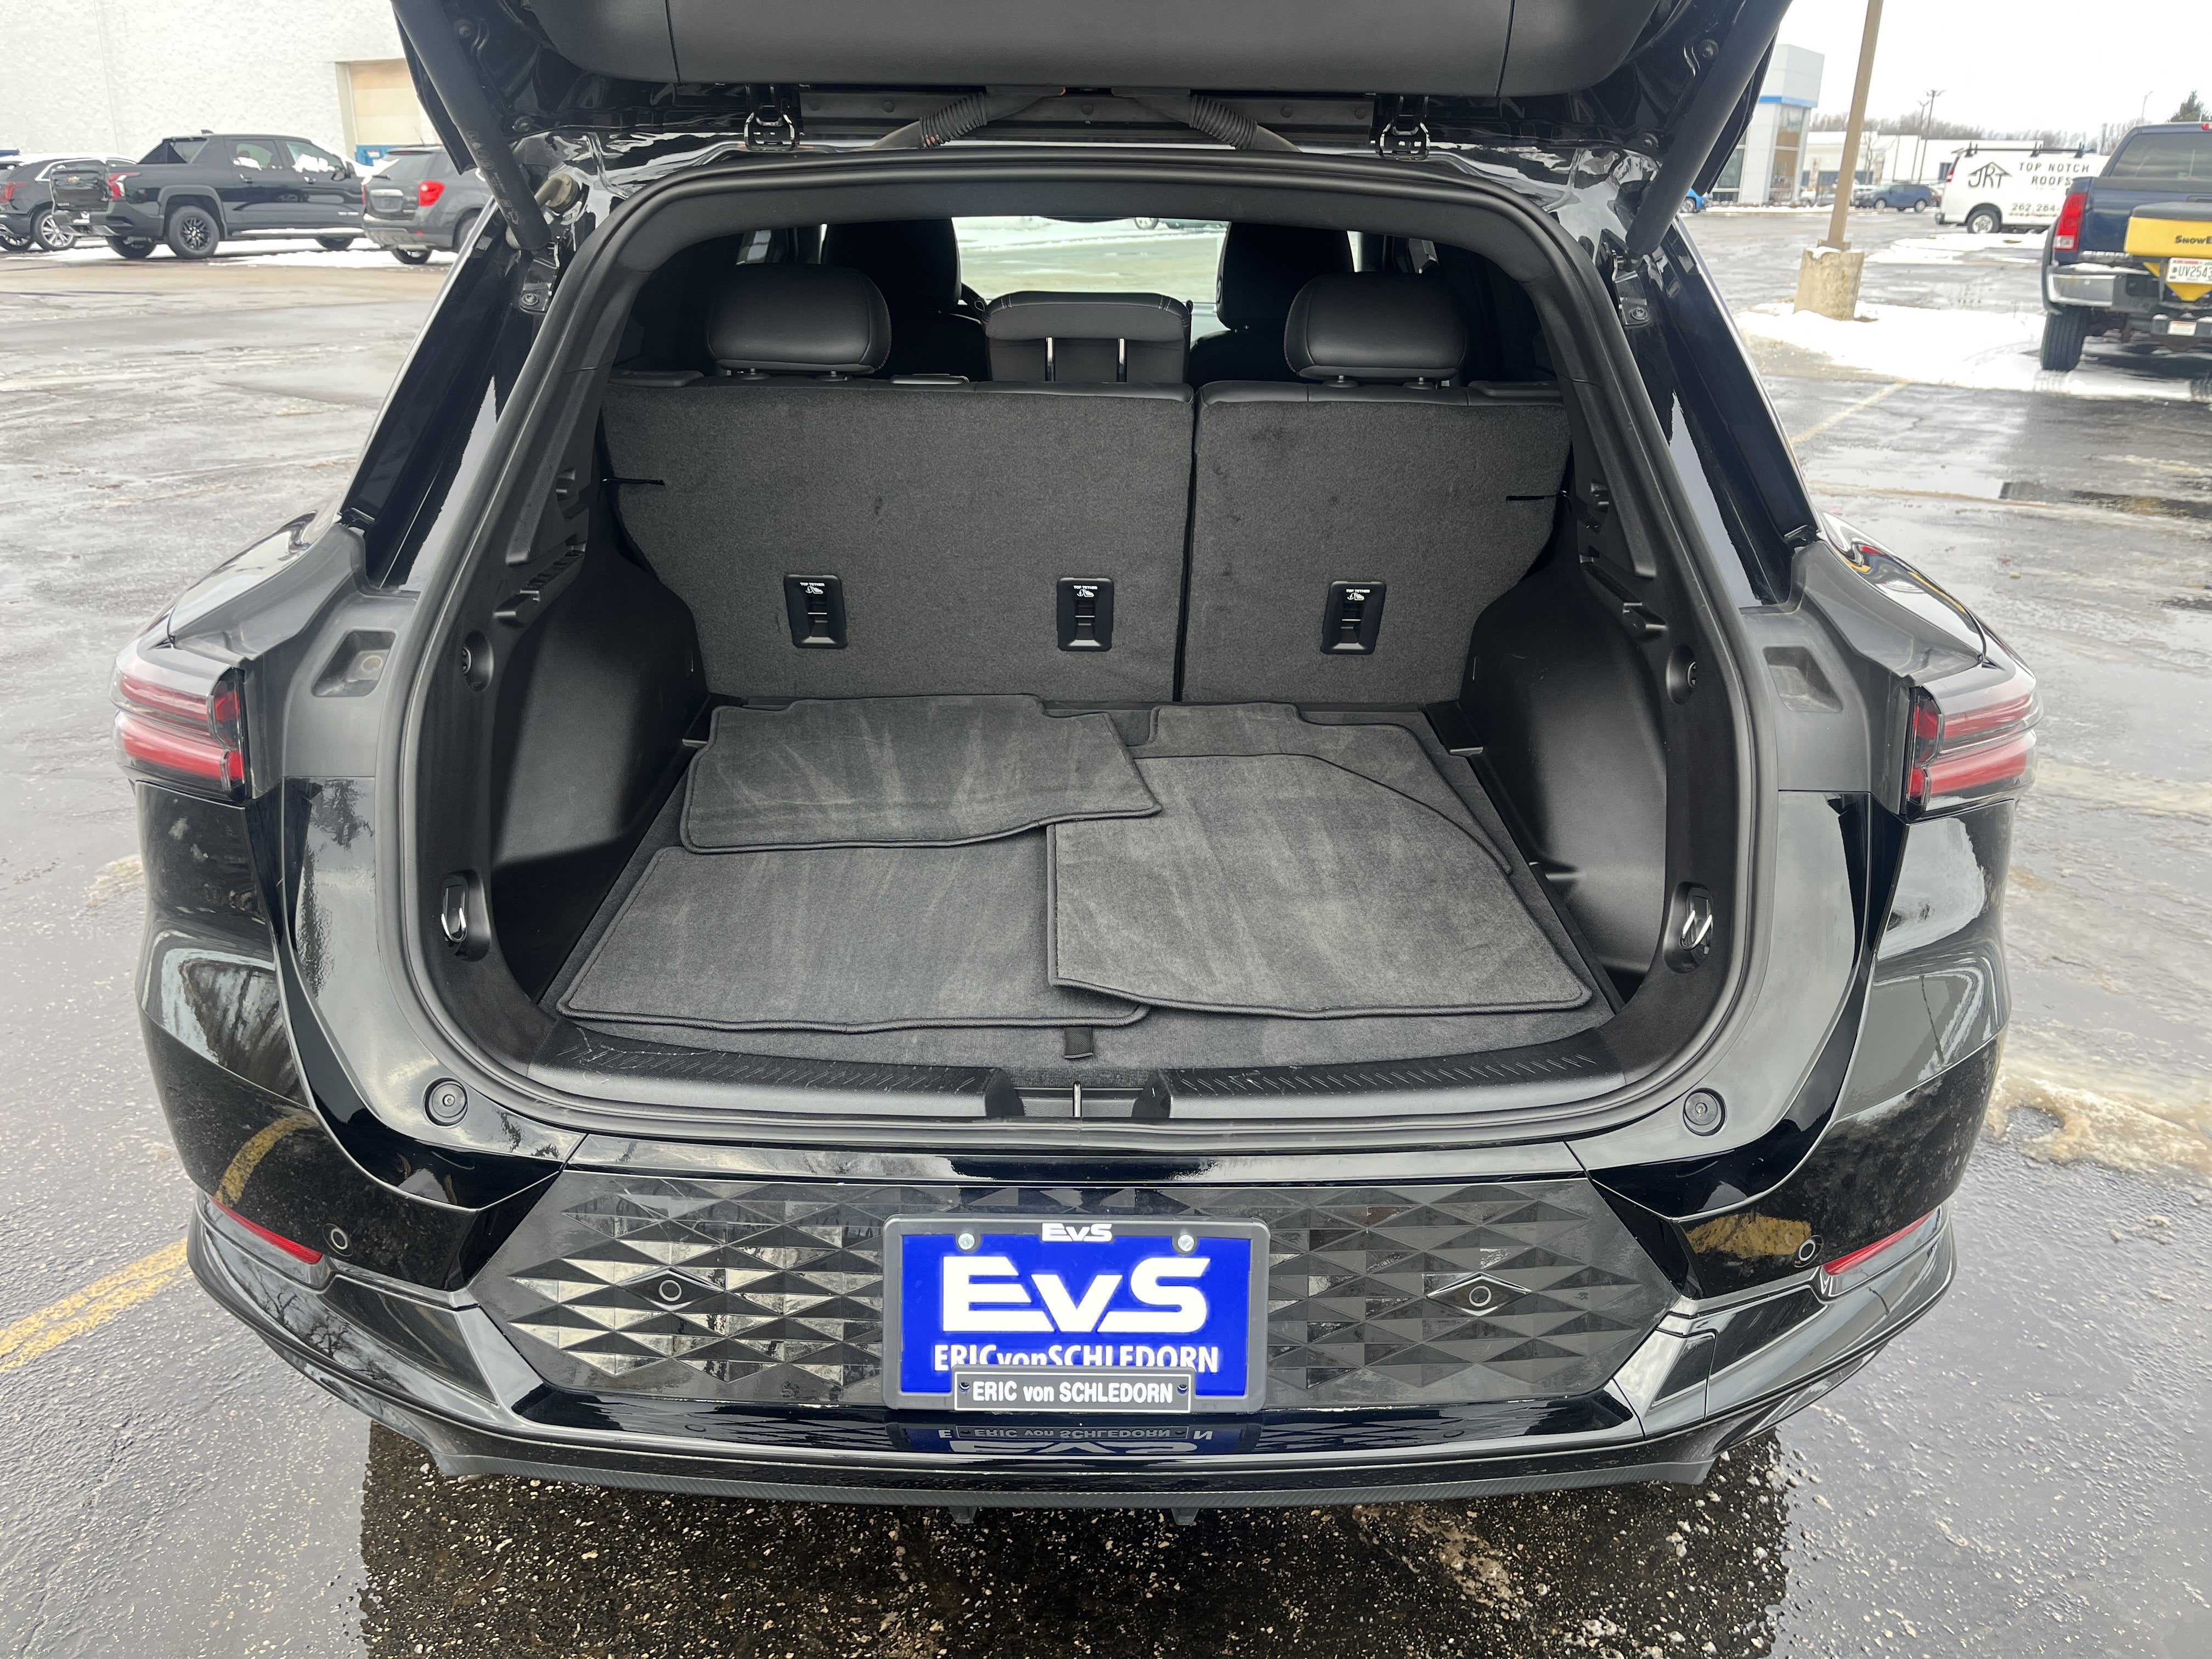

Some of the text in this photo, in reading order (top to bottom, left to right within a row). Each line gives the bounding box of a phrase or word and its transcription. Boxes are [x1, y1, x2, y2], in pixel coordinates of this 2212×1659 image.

[2019, 162, 2089, 173] TOP NOTCH
[973, 1380, 1173, 1403] ERIC von SCHLEDORN
